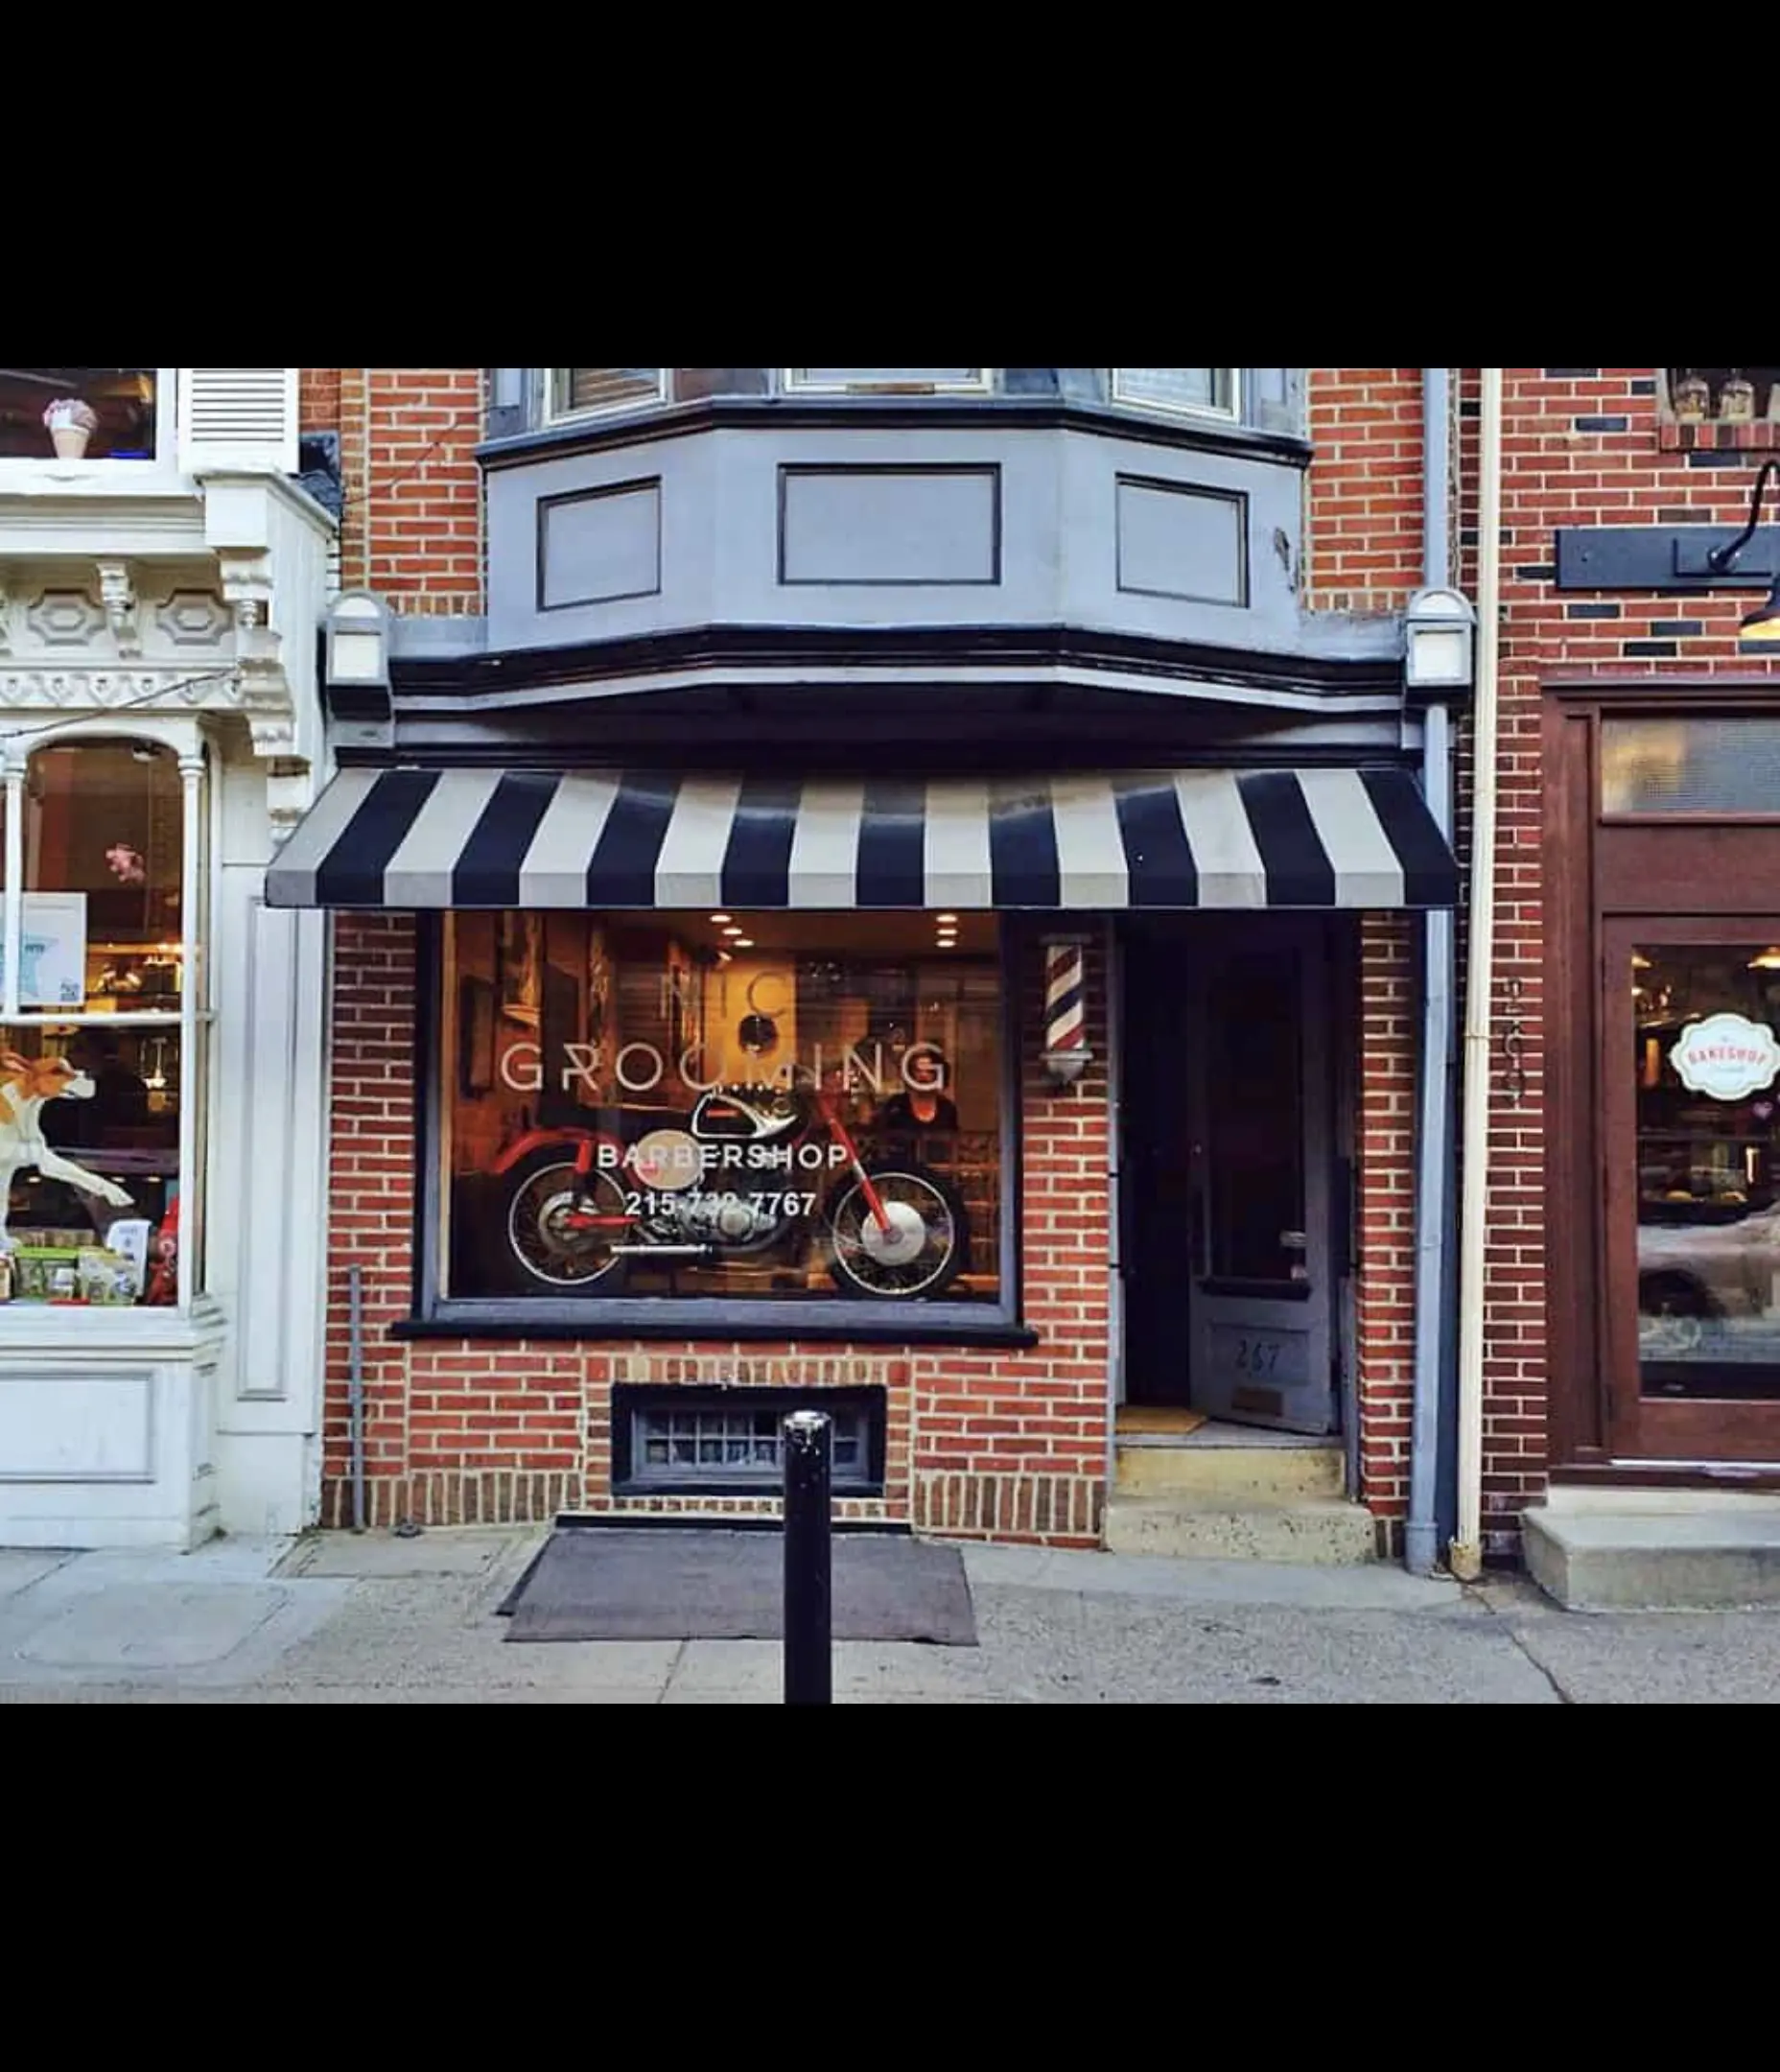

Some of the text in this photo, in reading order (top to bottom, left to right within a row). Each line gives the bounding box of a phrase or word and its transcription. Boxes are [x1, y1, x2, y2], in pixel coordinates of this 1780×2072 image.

[501, 1042, 945, 1092] GROOMING
[1688, 1047, 1768, 1066] BAKESHOP
[597, 1143, 848, 1169] BARBERSHOP
[1236, 1338, 1279, 1374] 267
